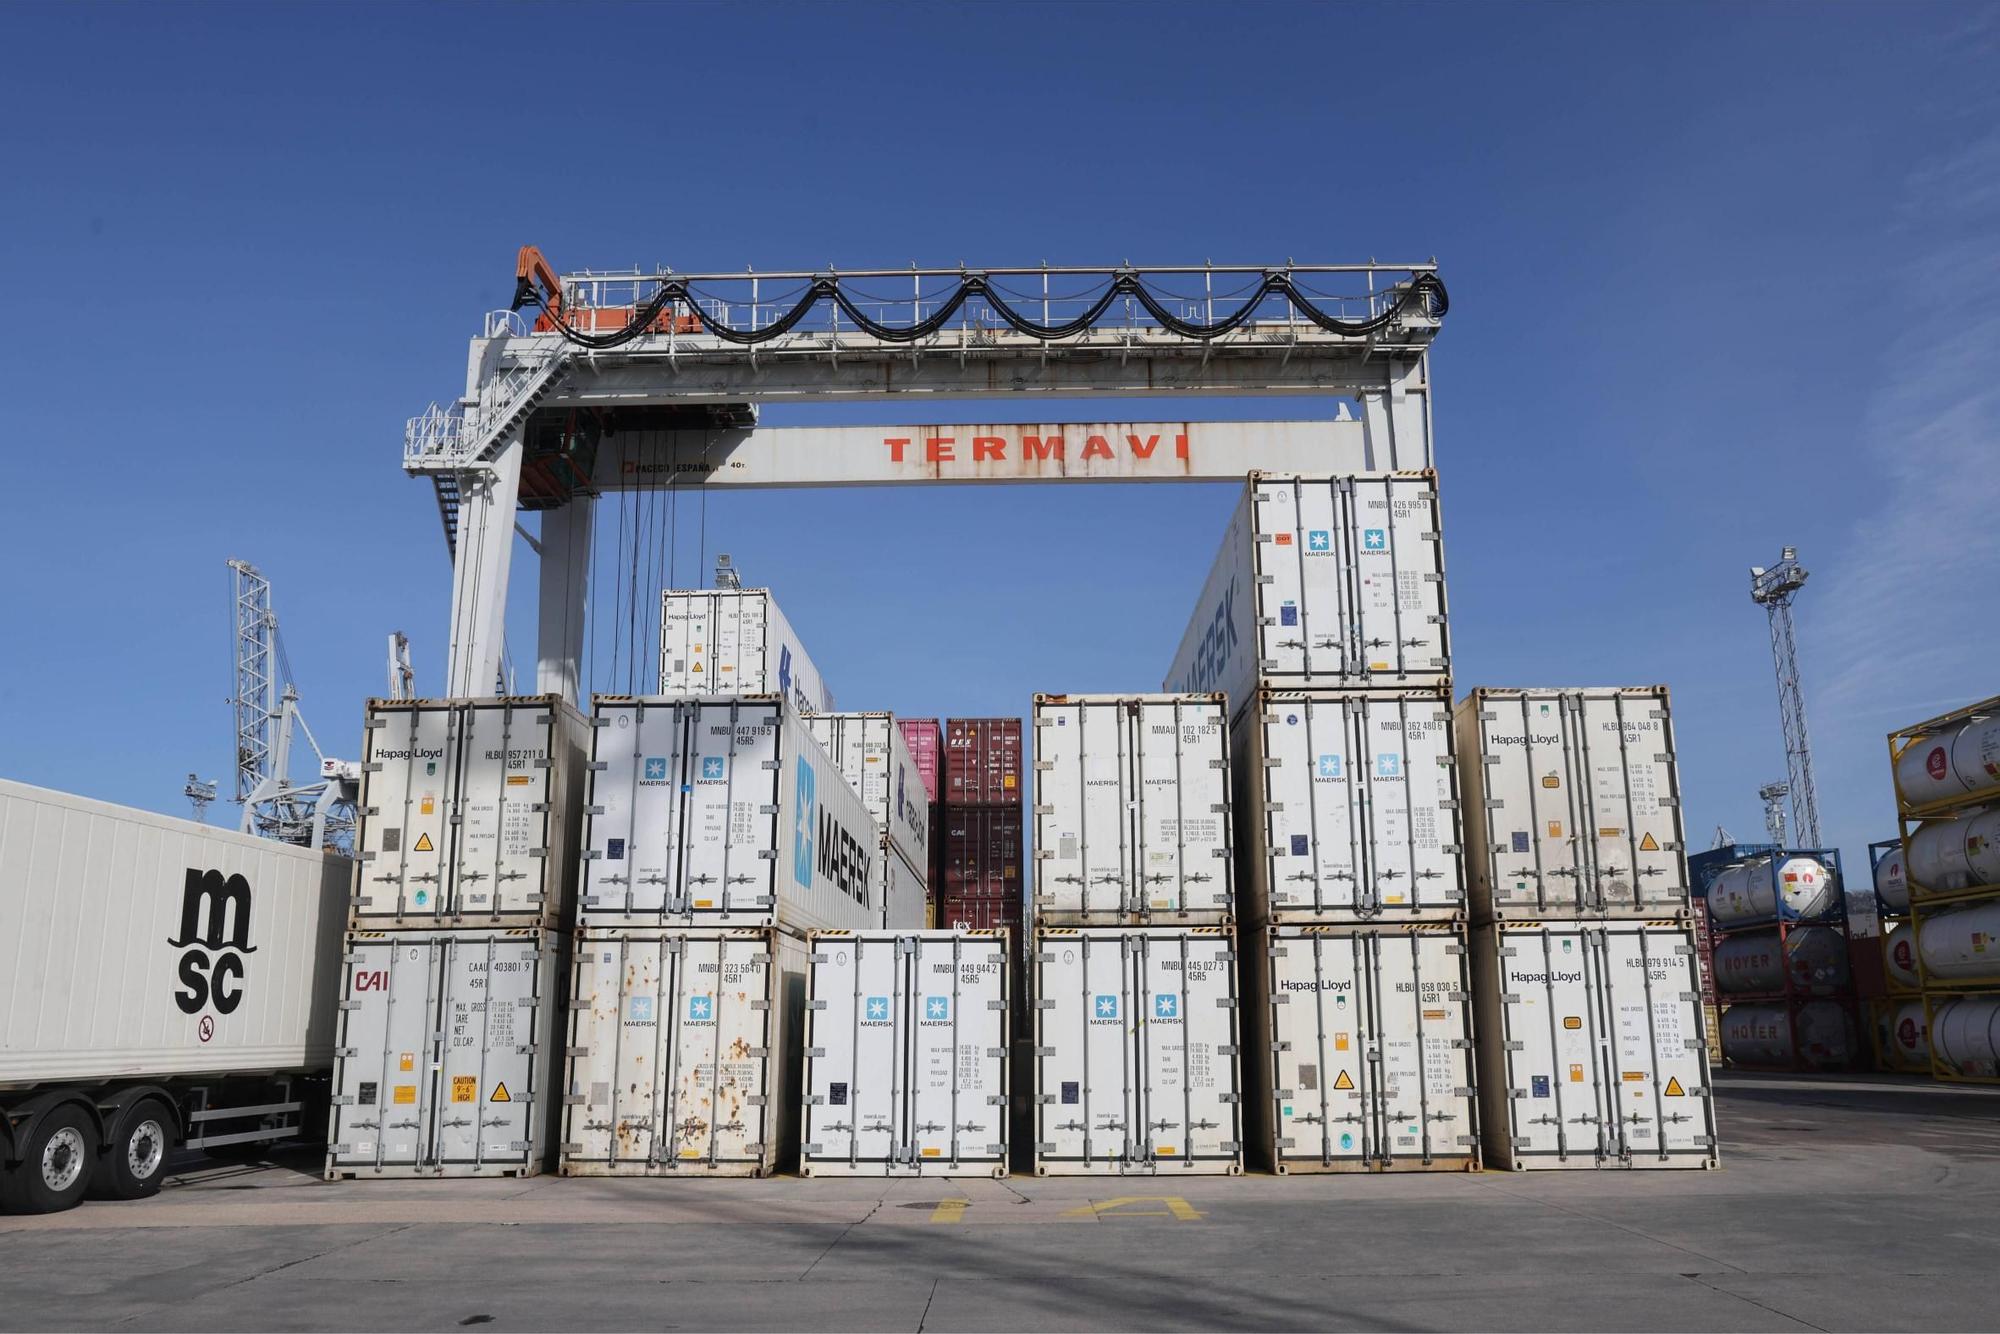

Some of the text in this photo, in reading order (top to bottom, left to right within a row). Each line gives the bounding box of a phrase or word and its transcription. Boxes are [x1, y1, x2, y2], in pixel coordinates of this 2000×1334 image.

[884, 434, 1189, 463] TERMAVI
[1491, 733, 1559, 747] Hapag Lloyd
[818, 803, 871, 910] MAERSK
[469, 963, 488, 972] CAAU
[494, 962, 521, 972] 403801
[1162, 961, 1182, 971] MNBU
[1188, 961, 1202, 971] 445
[1203, 961, 1217, 971] 027
[1627, 958, 1645, 968] HLBU
[1647, 958, 1661, 968] 979
[1663, 958, 1677, 968] 914
[1725, 953, 1769, 971] HOYER
[933, 964, 954, 974] MNBU
[960, 964, 974, 974] 449
[976, 964, 990, 974] 944
[960, 974, 979, 984] 45R5
[1188, 972, 1207, 981] 45R5
[1511, 971, 1581, 984] Hapag Lloyd
[1648, 971, 1667, 980] 45R5
[355, 971, 388, 991] CAI
[1281, 979, 1351, 992] Hapag Lloyd
[1396, 982, 1415, 992] HLBU
[1421, 982, 1435, 992] 958
[1437, 982, 1450, 992] 030
[1421, 993, 1440, 1003] 45R1
[471, 1003, 486, 1012] GROSS
[456, 1014, 468, 1024] TARE
[454, 1026, 464, 1035] NET
[1732, 1025, 1777, 1040] HOYER
[453, 1076, 476, 1084] CAUTION
[457, 1094, 470, 1102] HIGH
